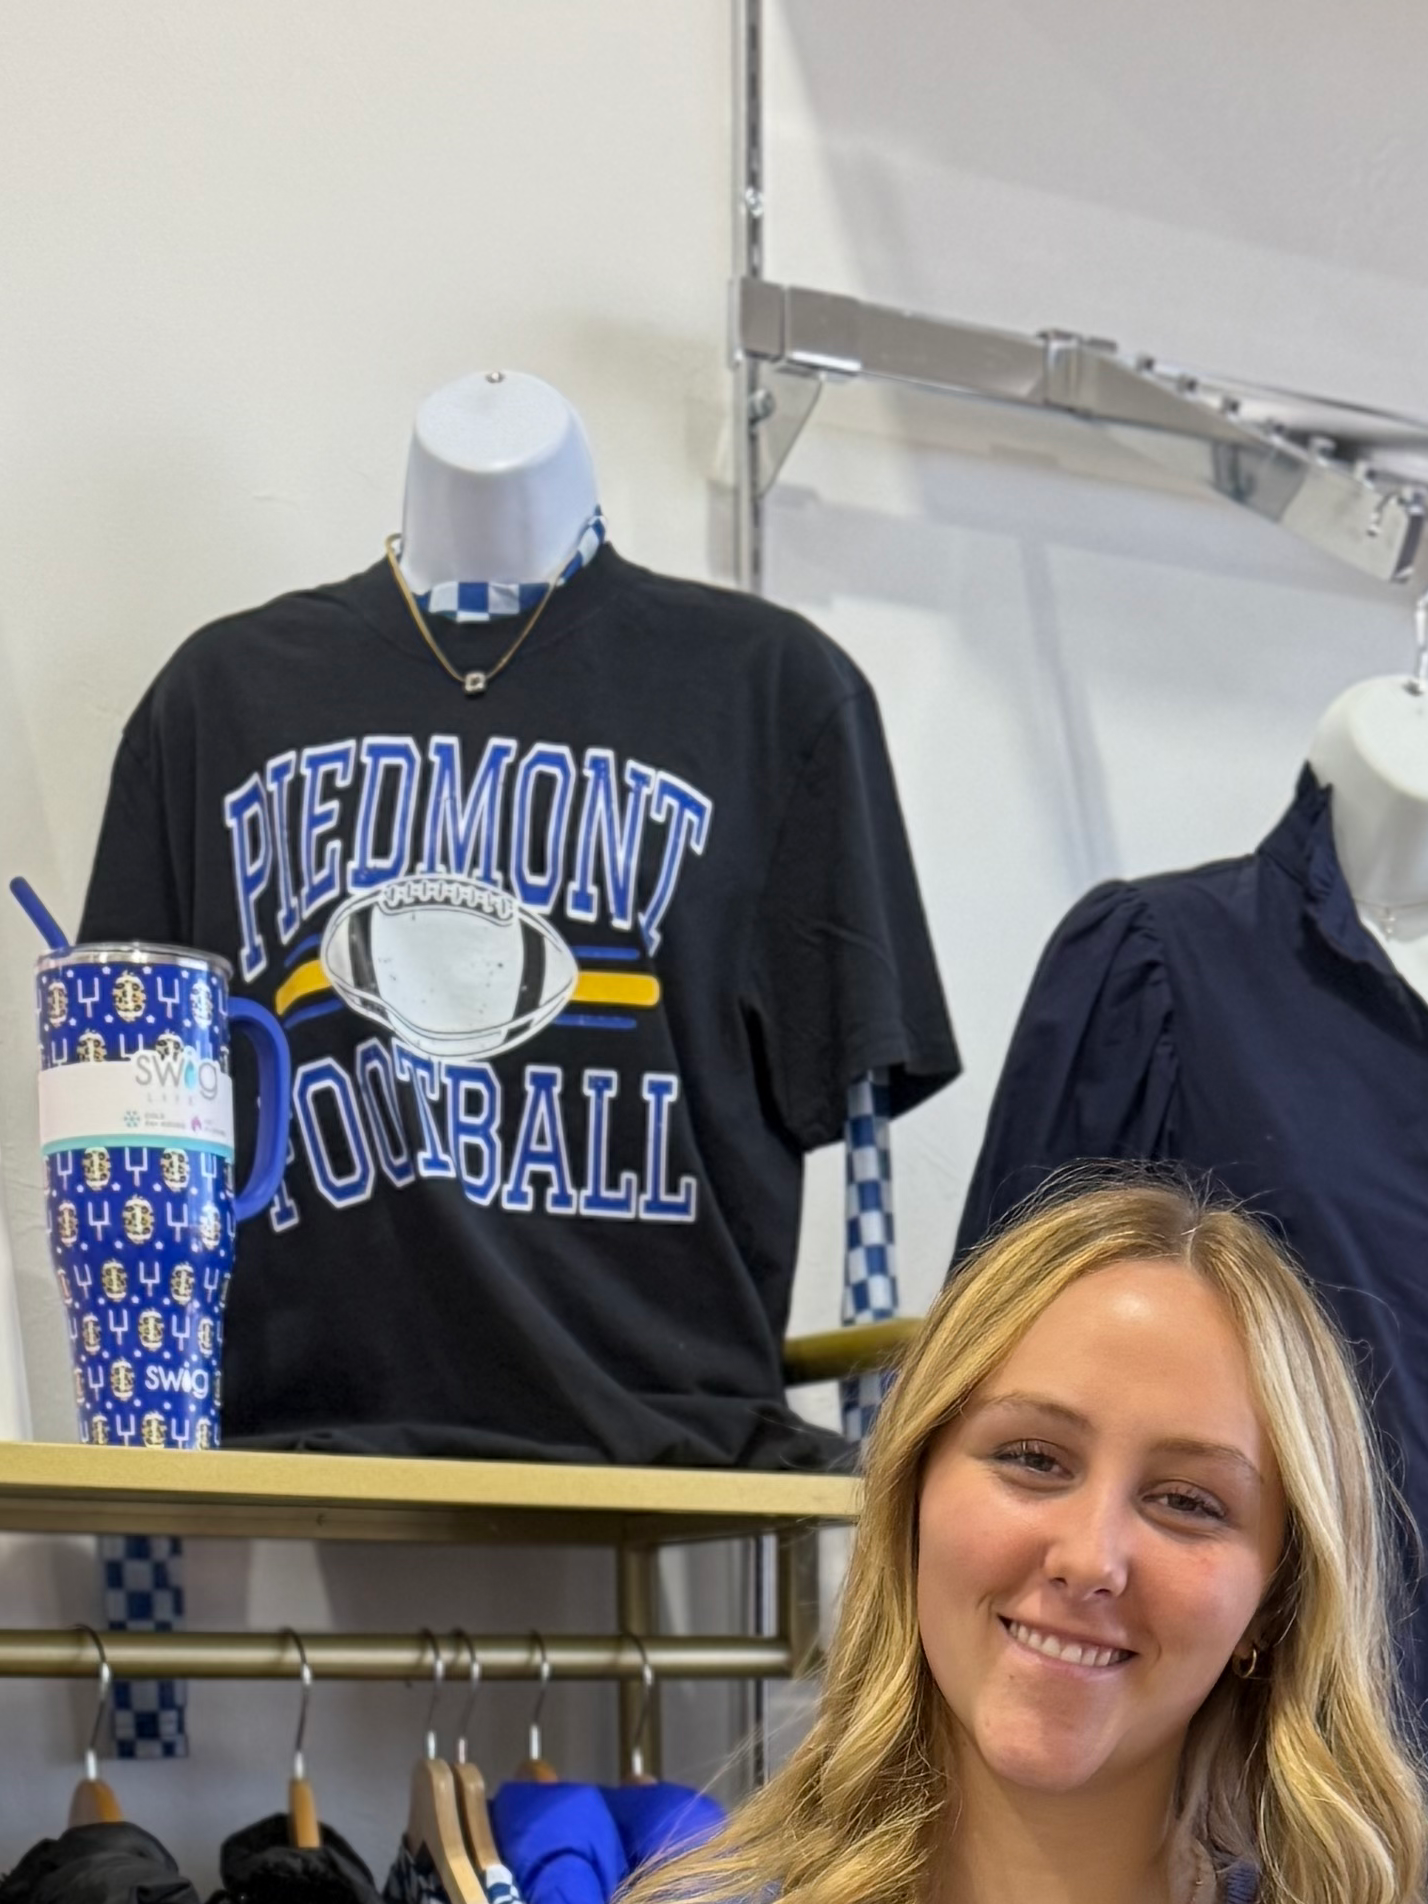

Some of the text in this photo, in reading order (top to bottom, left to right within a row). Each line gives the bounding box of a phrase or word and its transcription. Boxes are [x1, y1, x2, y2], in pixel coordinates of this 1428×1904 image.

[224, 735, 712, 982] PIEDMONT
[267, 1037, 698, 1233] OOTBALL
[144, 1360, 209, 1400] swig
